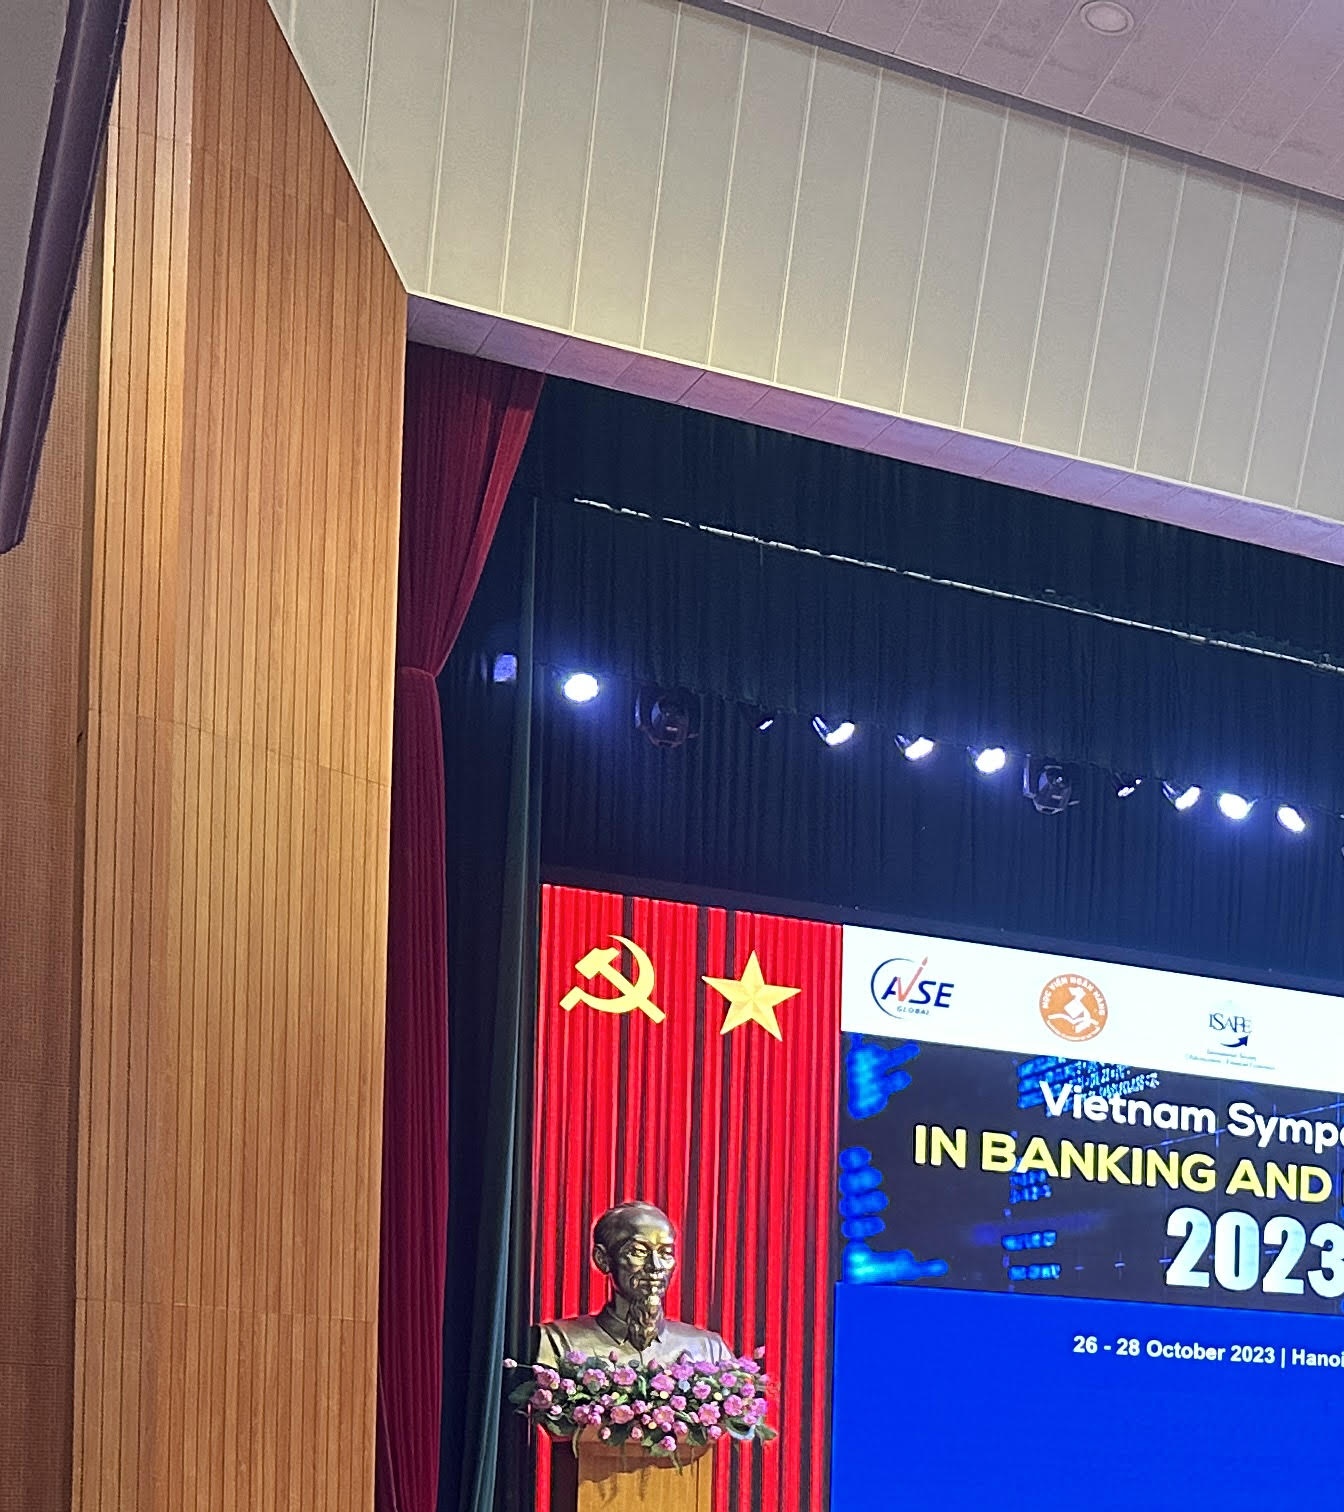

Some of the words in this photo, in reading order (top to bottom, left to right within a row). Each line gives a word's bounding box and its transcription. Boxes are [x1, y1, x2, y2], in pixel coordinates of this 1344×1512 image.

[1039, 1080, 1217, 1135] Vietnam
[914, 1124, 967, 1169] IN
[981, 1131, 1217, 1193] BANKING
[1225, 1158, 1333, 1203] AND
[1072, 1335, 1098, 1354] 26
[1116, 1337, 1141, 1357] 28
[1146, 1339, 1227, 1362] October
[1230, 1345, 1276, 1364] 2023
